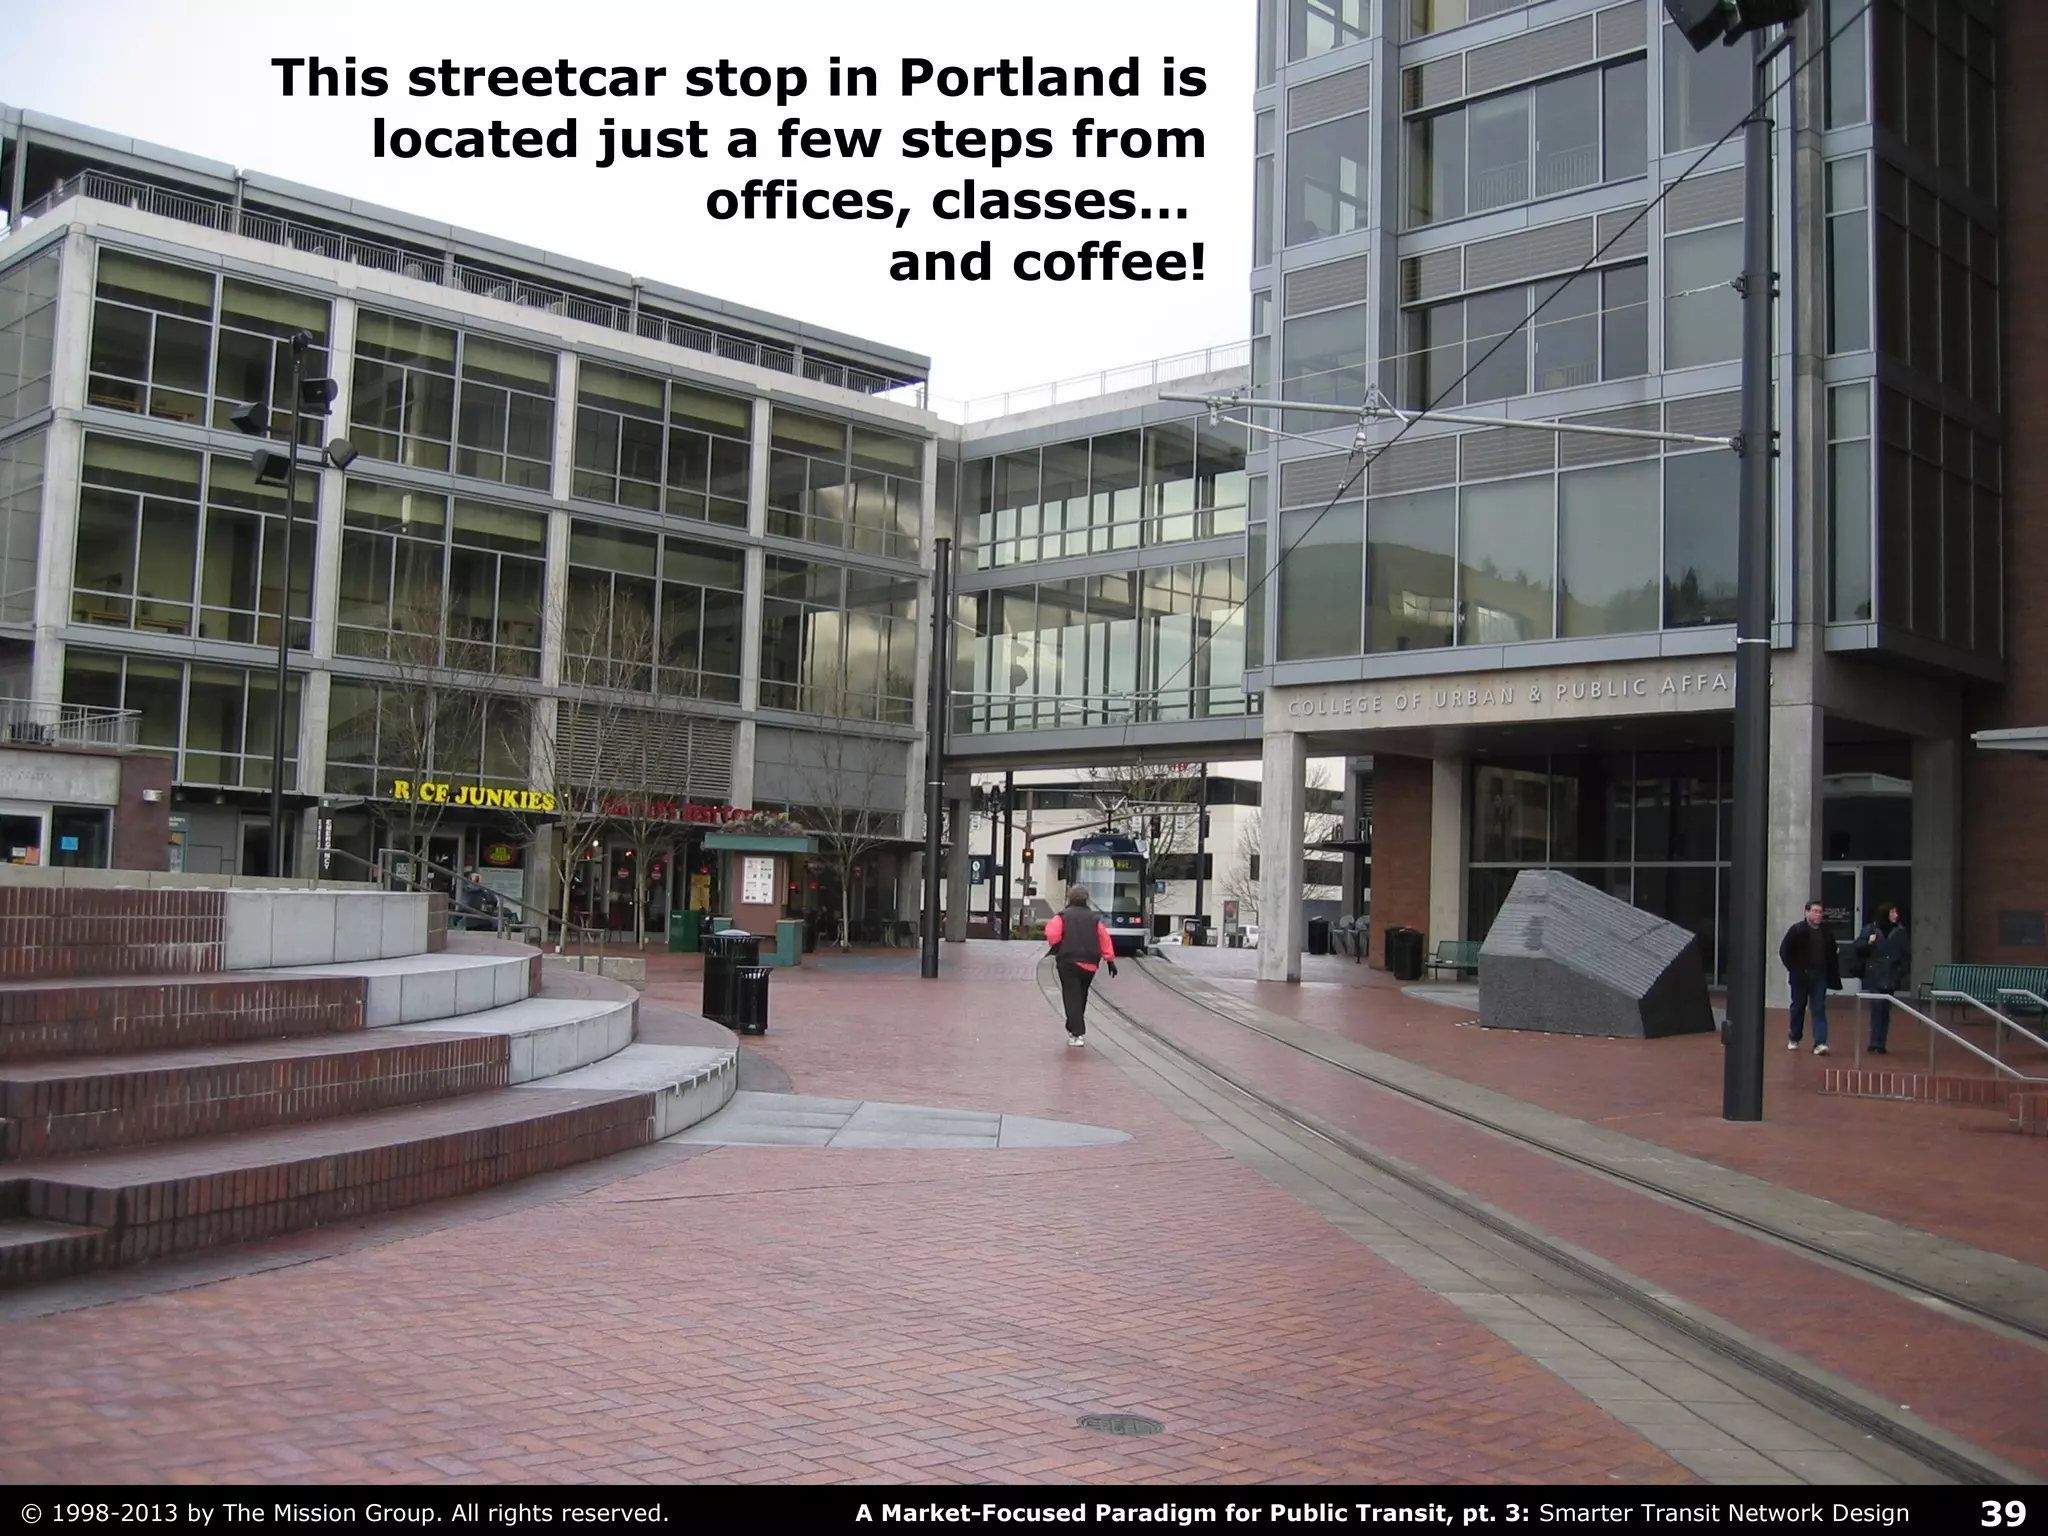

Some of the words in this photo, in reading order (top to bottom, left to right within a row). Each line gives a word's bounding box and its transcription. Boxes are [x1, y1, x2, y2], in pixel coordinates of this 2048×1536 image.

[1288, 695, 1382, 716] COLLEGE
[1395, 694, 1422, 711] OF
[1435, 687, 1514, 709] URBAN
[1528, 685, 1541, 702] &
[1557, 678, 1646, 700] PUBLIC
[1661, 670, 1774, 694] AFFA
[394, 780, 449, 802] RCE
[455, 786, 557, 811] JUNKIES
